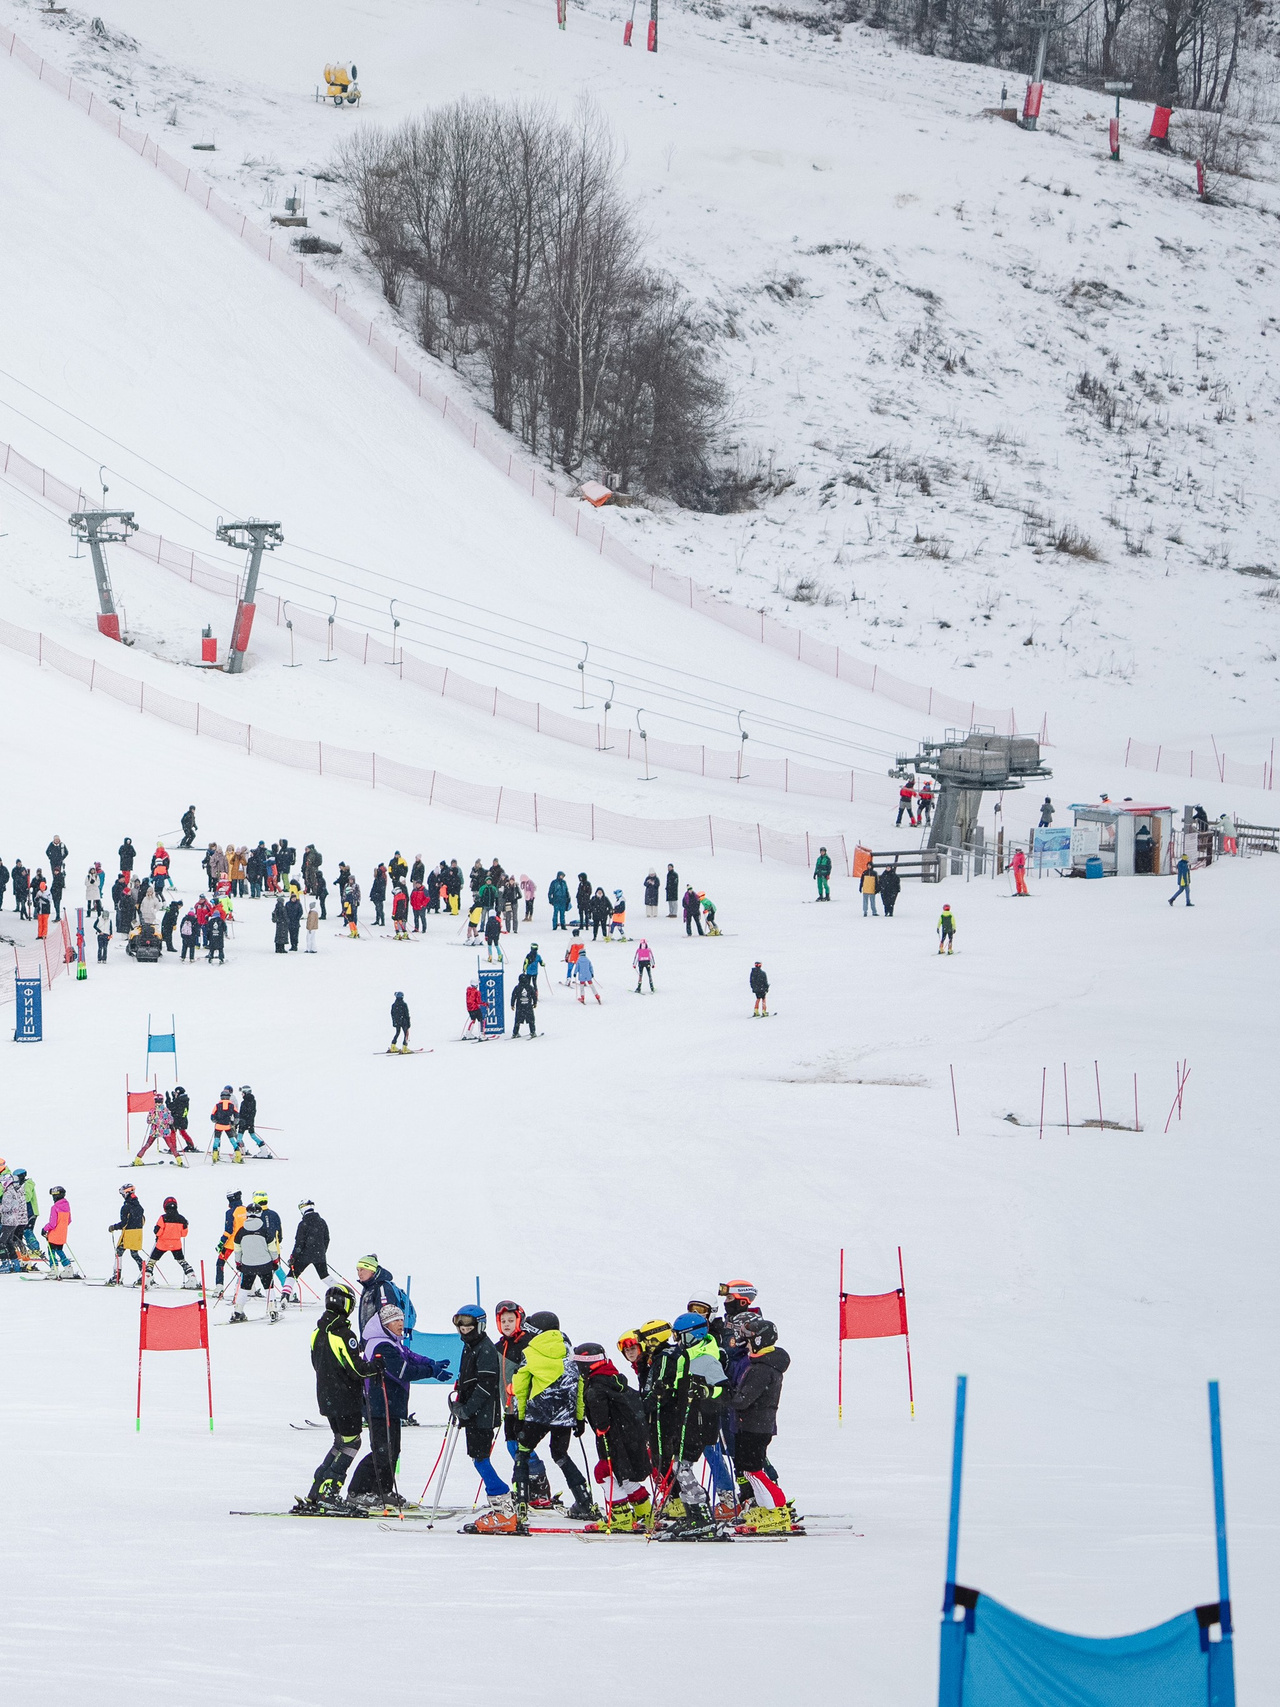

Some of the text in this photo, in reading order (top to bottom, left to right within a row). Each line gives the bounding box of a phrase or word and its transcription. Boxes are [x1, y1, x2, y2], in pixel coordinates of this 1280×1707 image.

[23, 988, 35, 1034] ФИНИШ
[486, 979, 498, 1025] ФИНИШ
[678, 1523, 716, 1536] FISCHER
[758, 1518, 789, 1529] FISCHER
